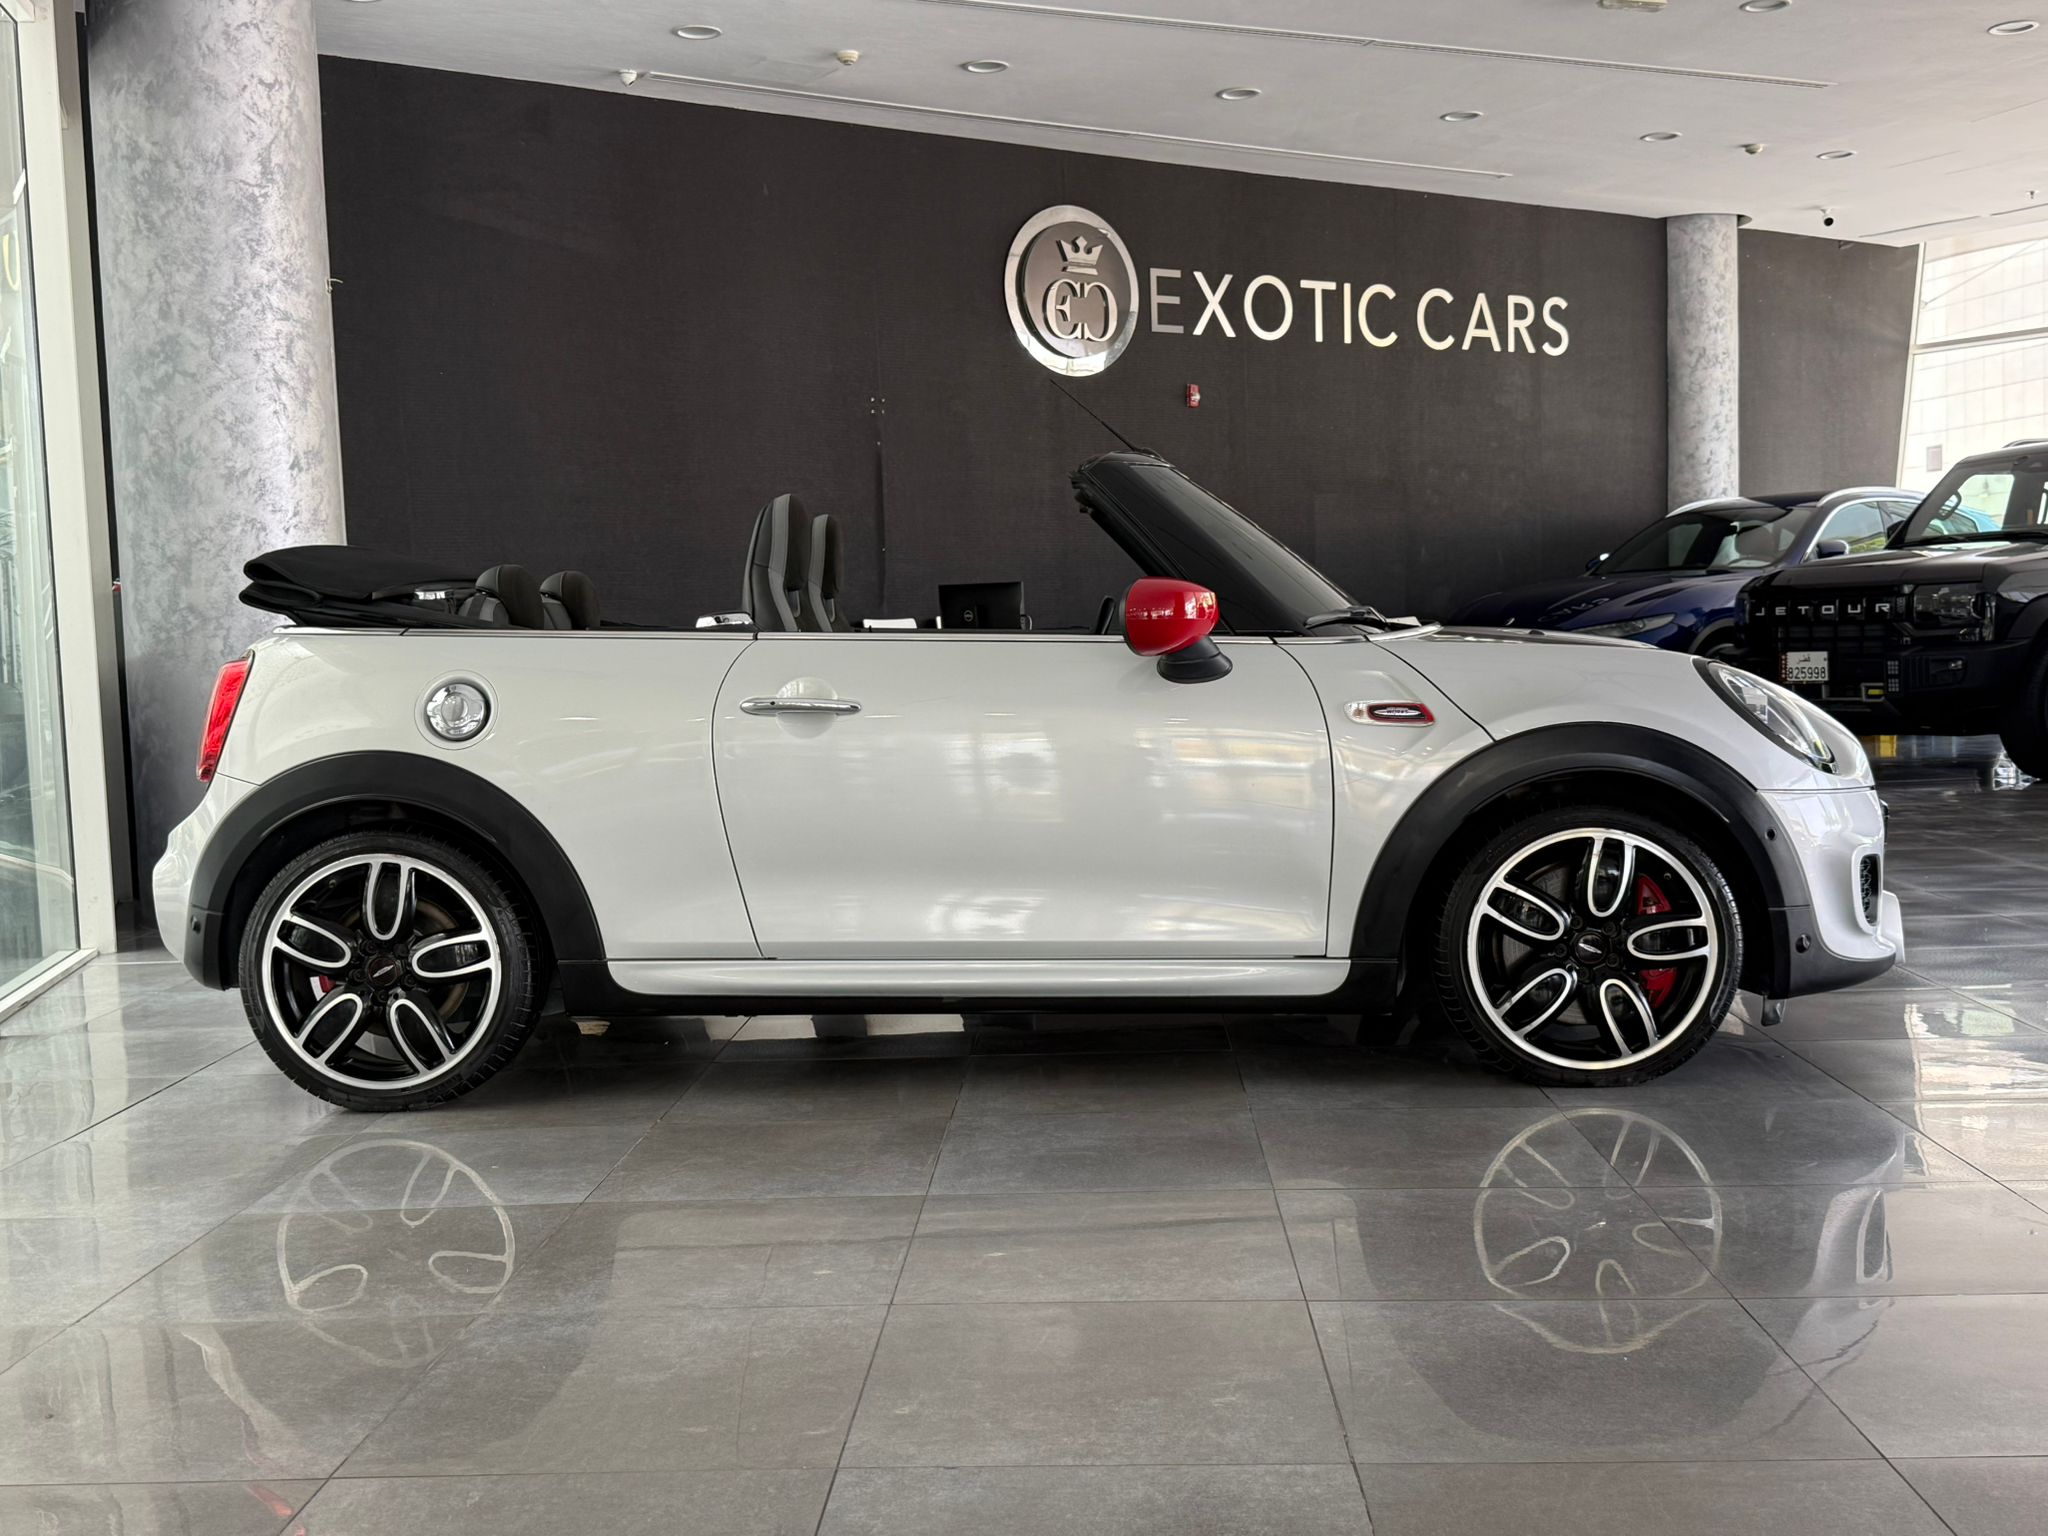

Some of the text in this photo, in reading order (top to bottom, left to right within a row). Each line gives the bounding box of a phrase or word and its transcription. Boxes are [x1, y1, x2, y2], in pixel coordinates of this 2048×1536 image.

[1149, 267, 1570, 357] EXOTIC CARS
[1755, 603, 1891, 616] JETOUR
[1787, 666, 1826, 680] 825998
